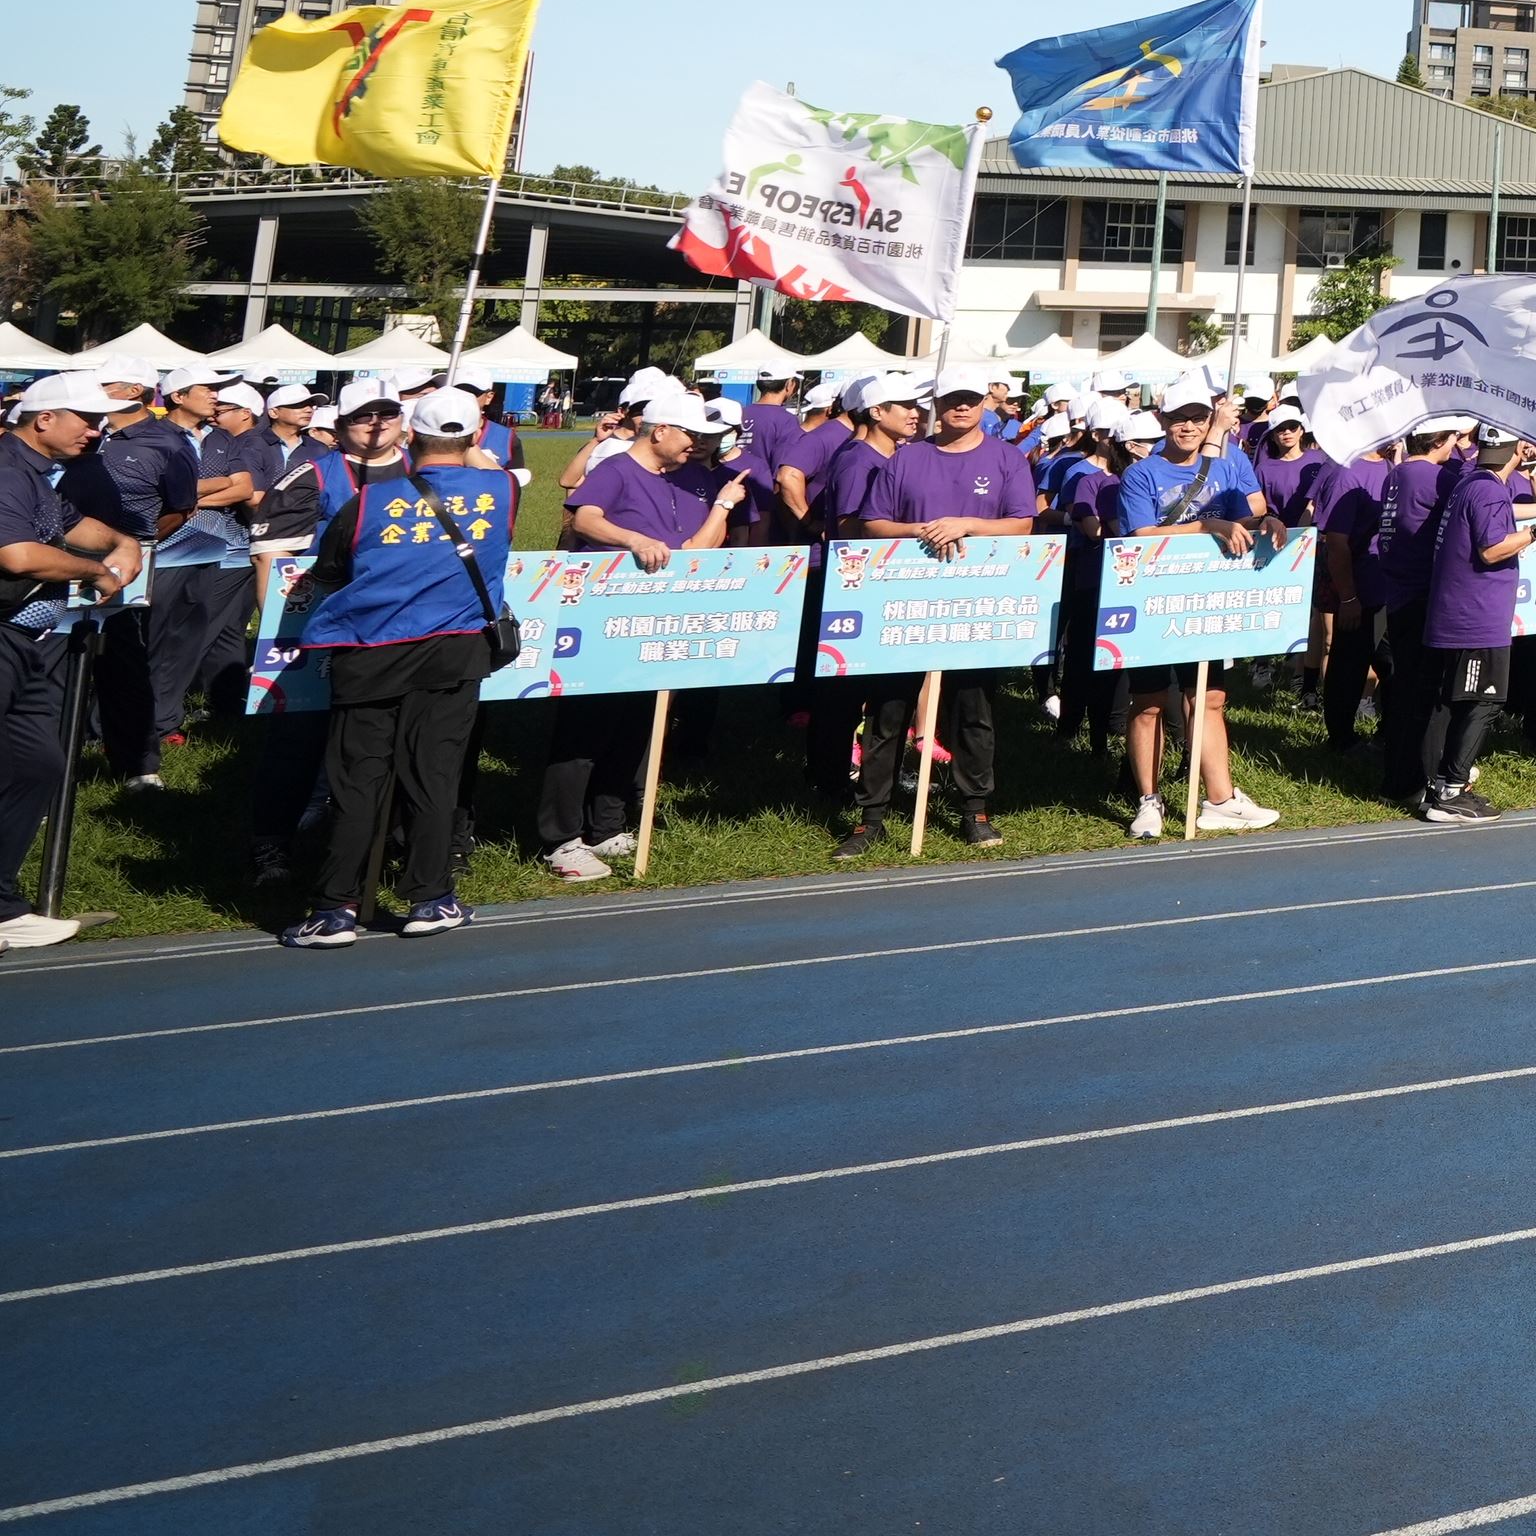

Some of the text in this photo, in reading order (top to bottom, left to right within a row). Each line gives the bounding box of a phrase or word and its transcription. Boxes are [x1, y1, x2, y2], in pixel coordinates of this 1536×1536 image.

[1144, 585, 1304, 615] 桃園市網路自媒體
[1515, 584, 1528, 599] 6
[882, 595, 1039, 621] 桃園市百貨食品
[1105, 613, 1130, 629] 47
[603, 610, 779, 639] 桃園市居家服務
[827, 618, 856, 634] 48
[880, 619, 1037, 646] 銷售員職業工會
[1162, 610, 1283, 639] 人員職業工會
[265, 648, 300, 664] 50
[638, 637, 740, 663] 職業工會
